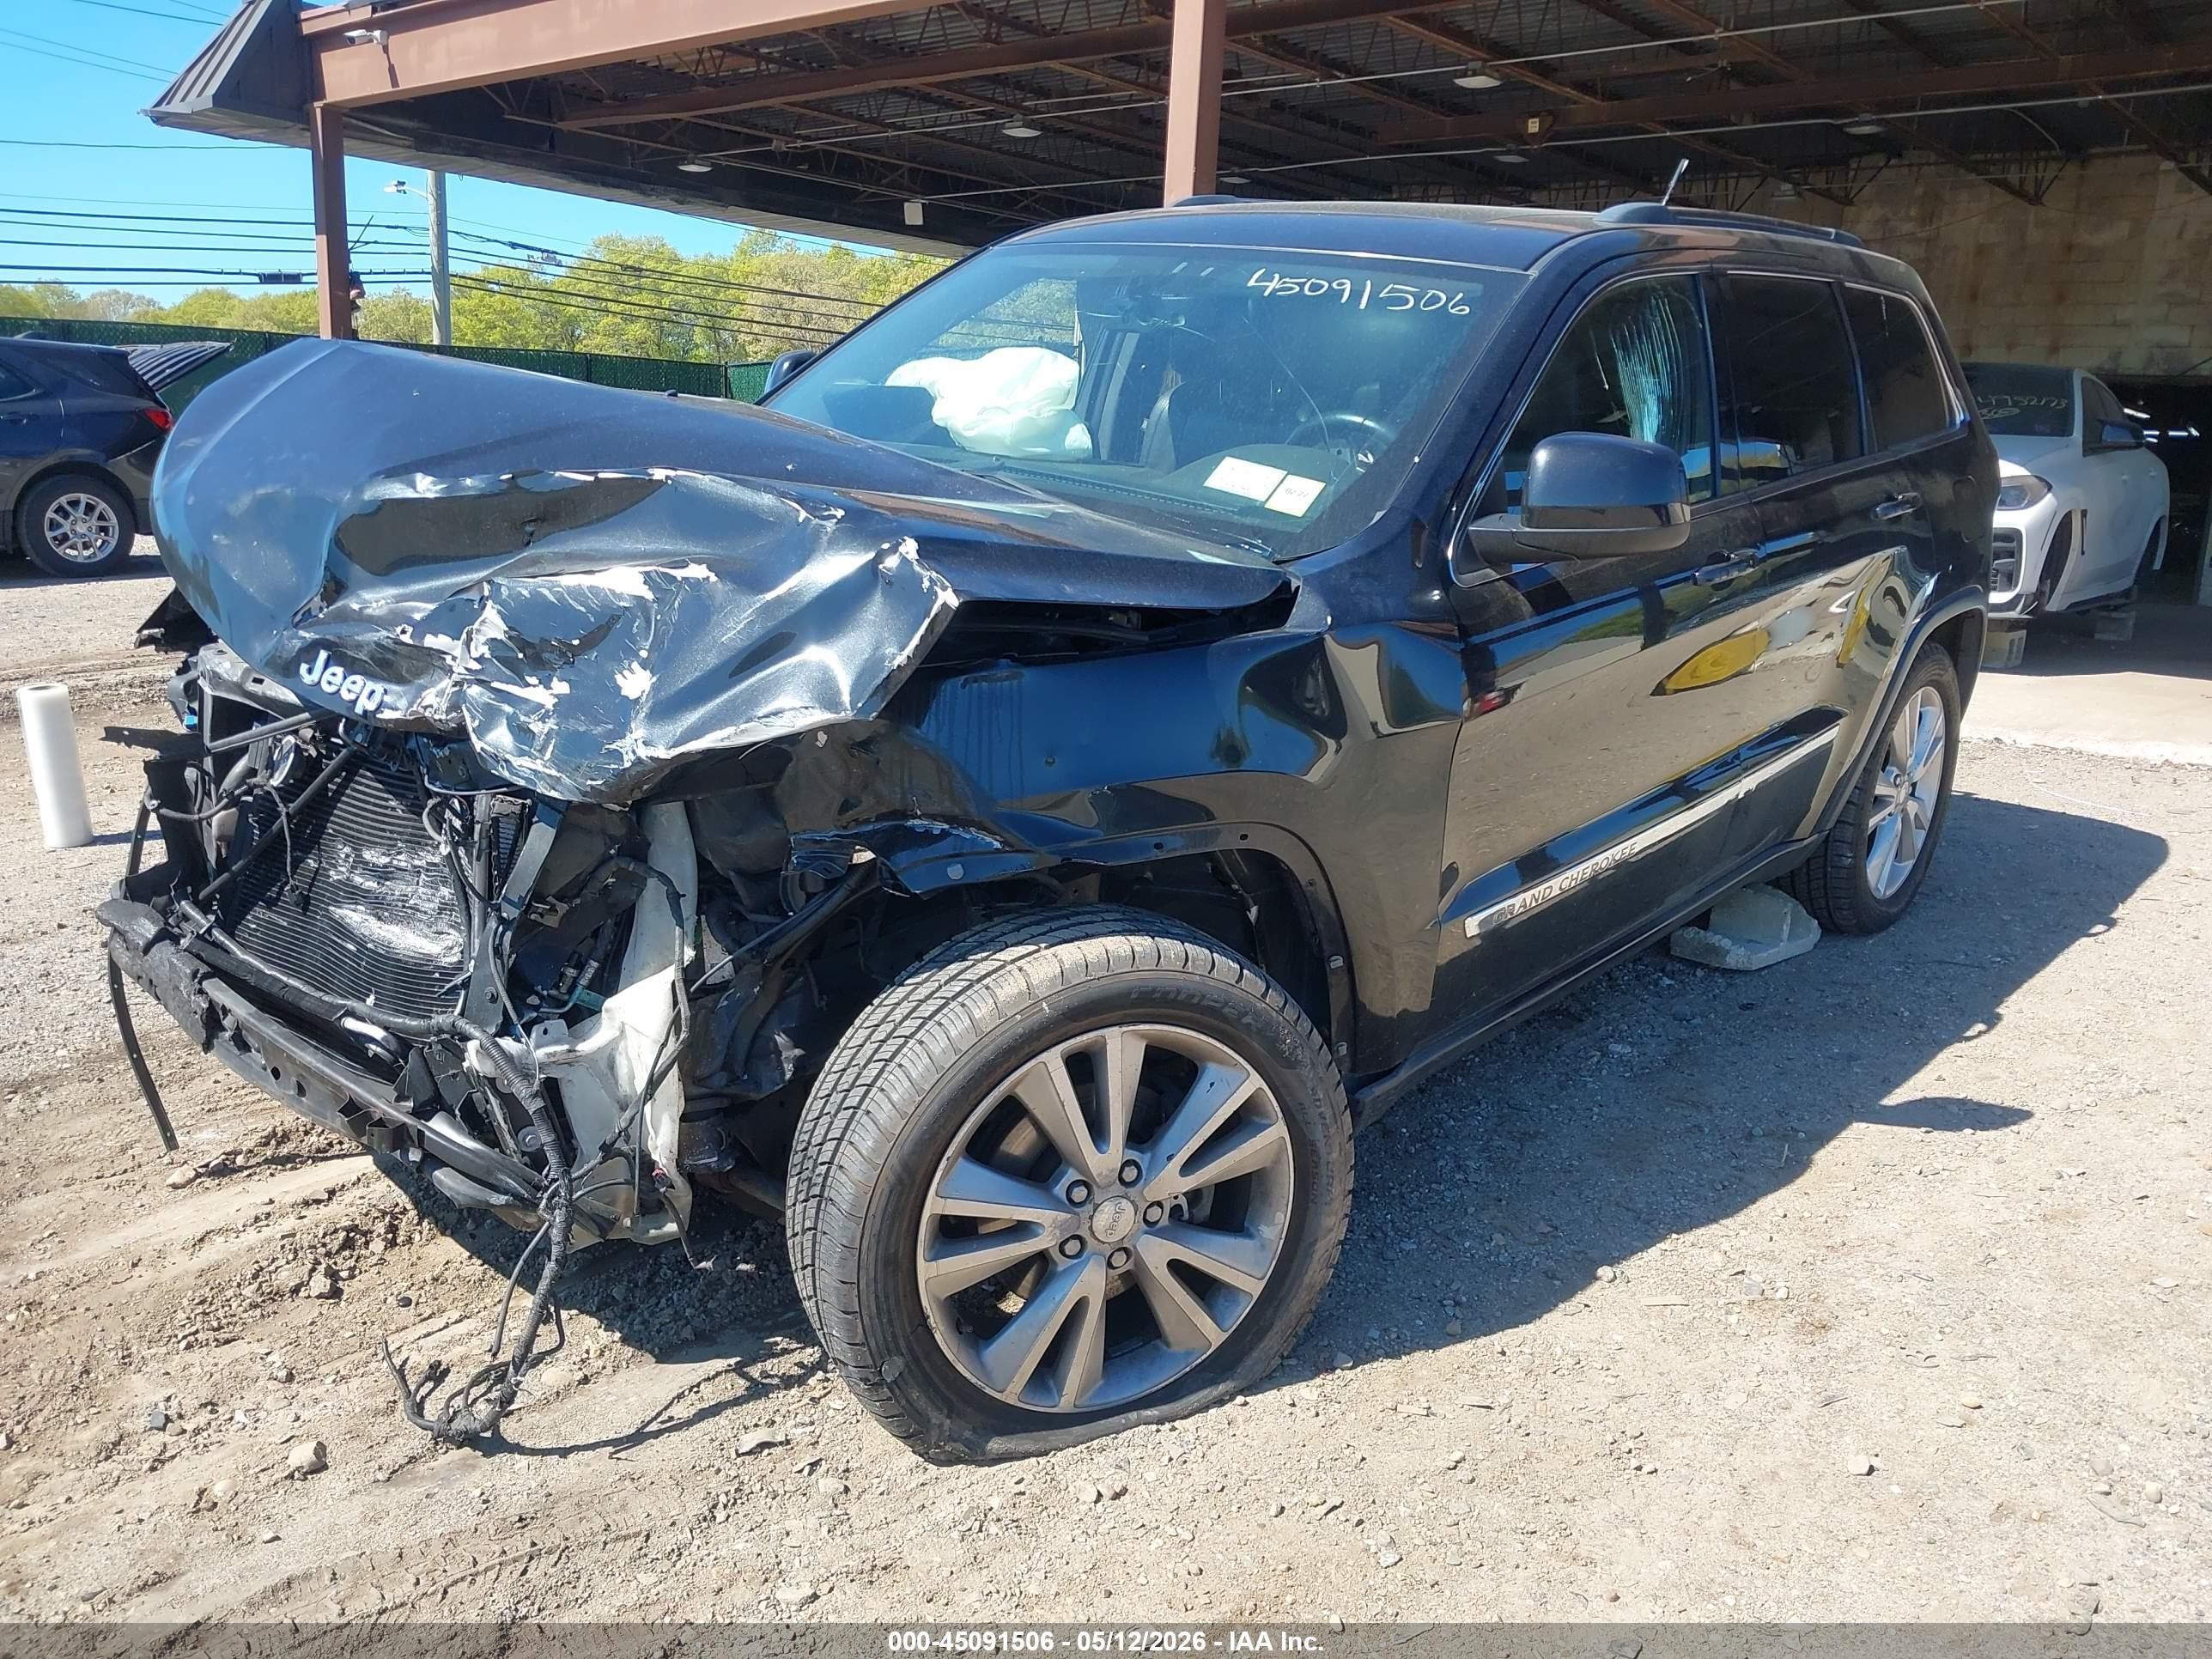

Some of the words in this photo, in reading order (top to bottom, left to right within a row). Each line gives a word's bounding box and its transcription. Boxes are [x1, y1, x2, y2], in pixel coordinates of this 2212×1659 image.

[1247, 268, 1471, 315] 45091506
[299, 649, 388, 715] Jeep
[1492, 885, 1553, 924] GRAND
[1558, 842, 1638, 892] CHEROKEE
[1105, 1202, 1127, 1237] Jeep
